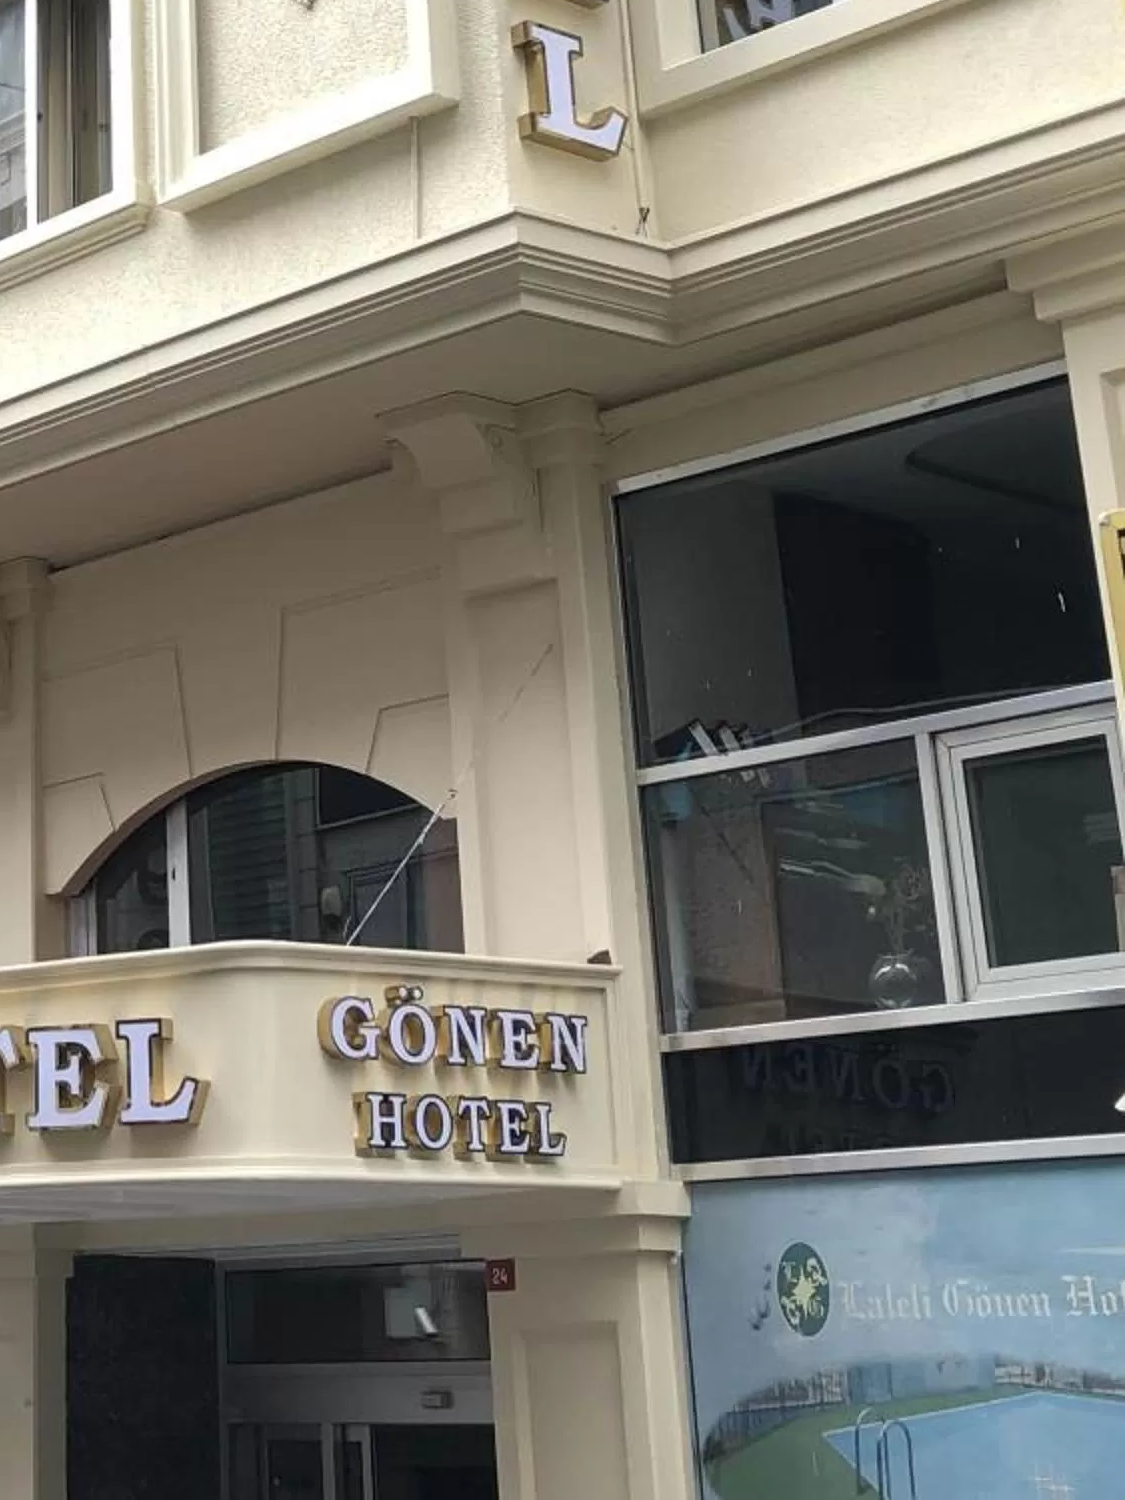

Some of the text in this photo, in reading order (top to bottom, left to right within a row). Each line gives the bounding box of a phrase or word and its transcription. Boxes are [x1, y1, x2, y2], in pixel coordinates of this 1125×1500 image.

[318, 984, 588, 1074] GÖNEN
[352, 1090, 567, 1157] HOTEL
[491, 1267, 508, 1285] 24
[942, 1279, 1052, 1317] Gönen
